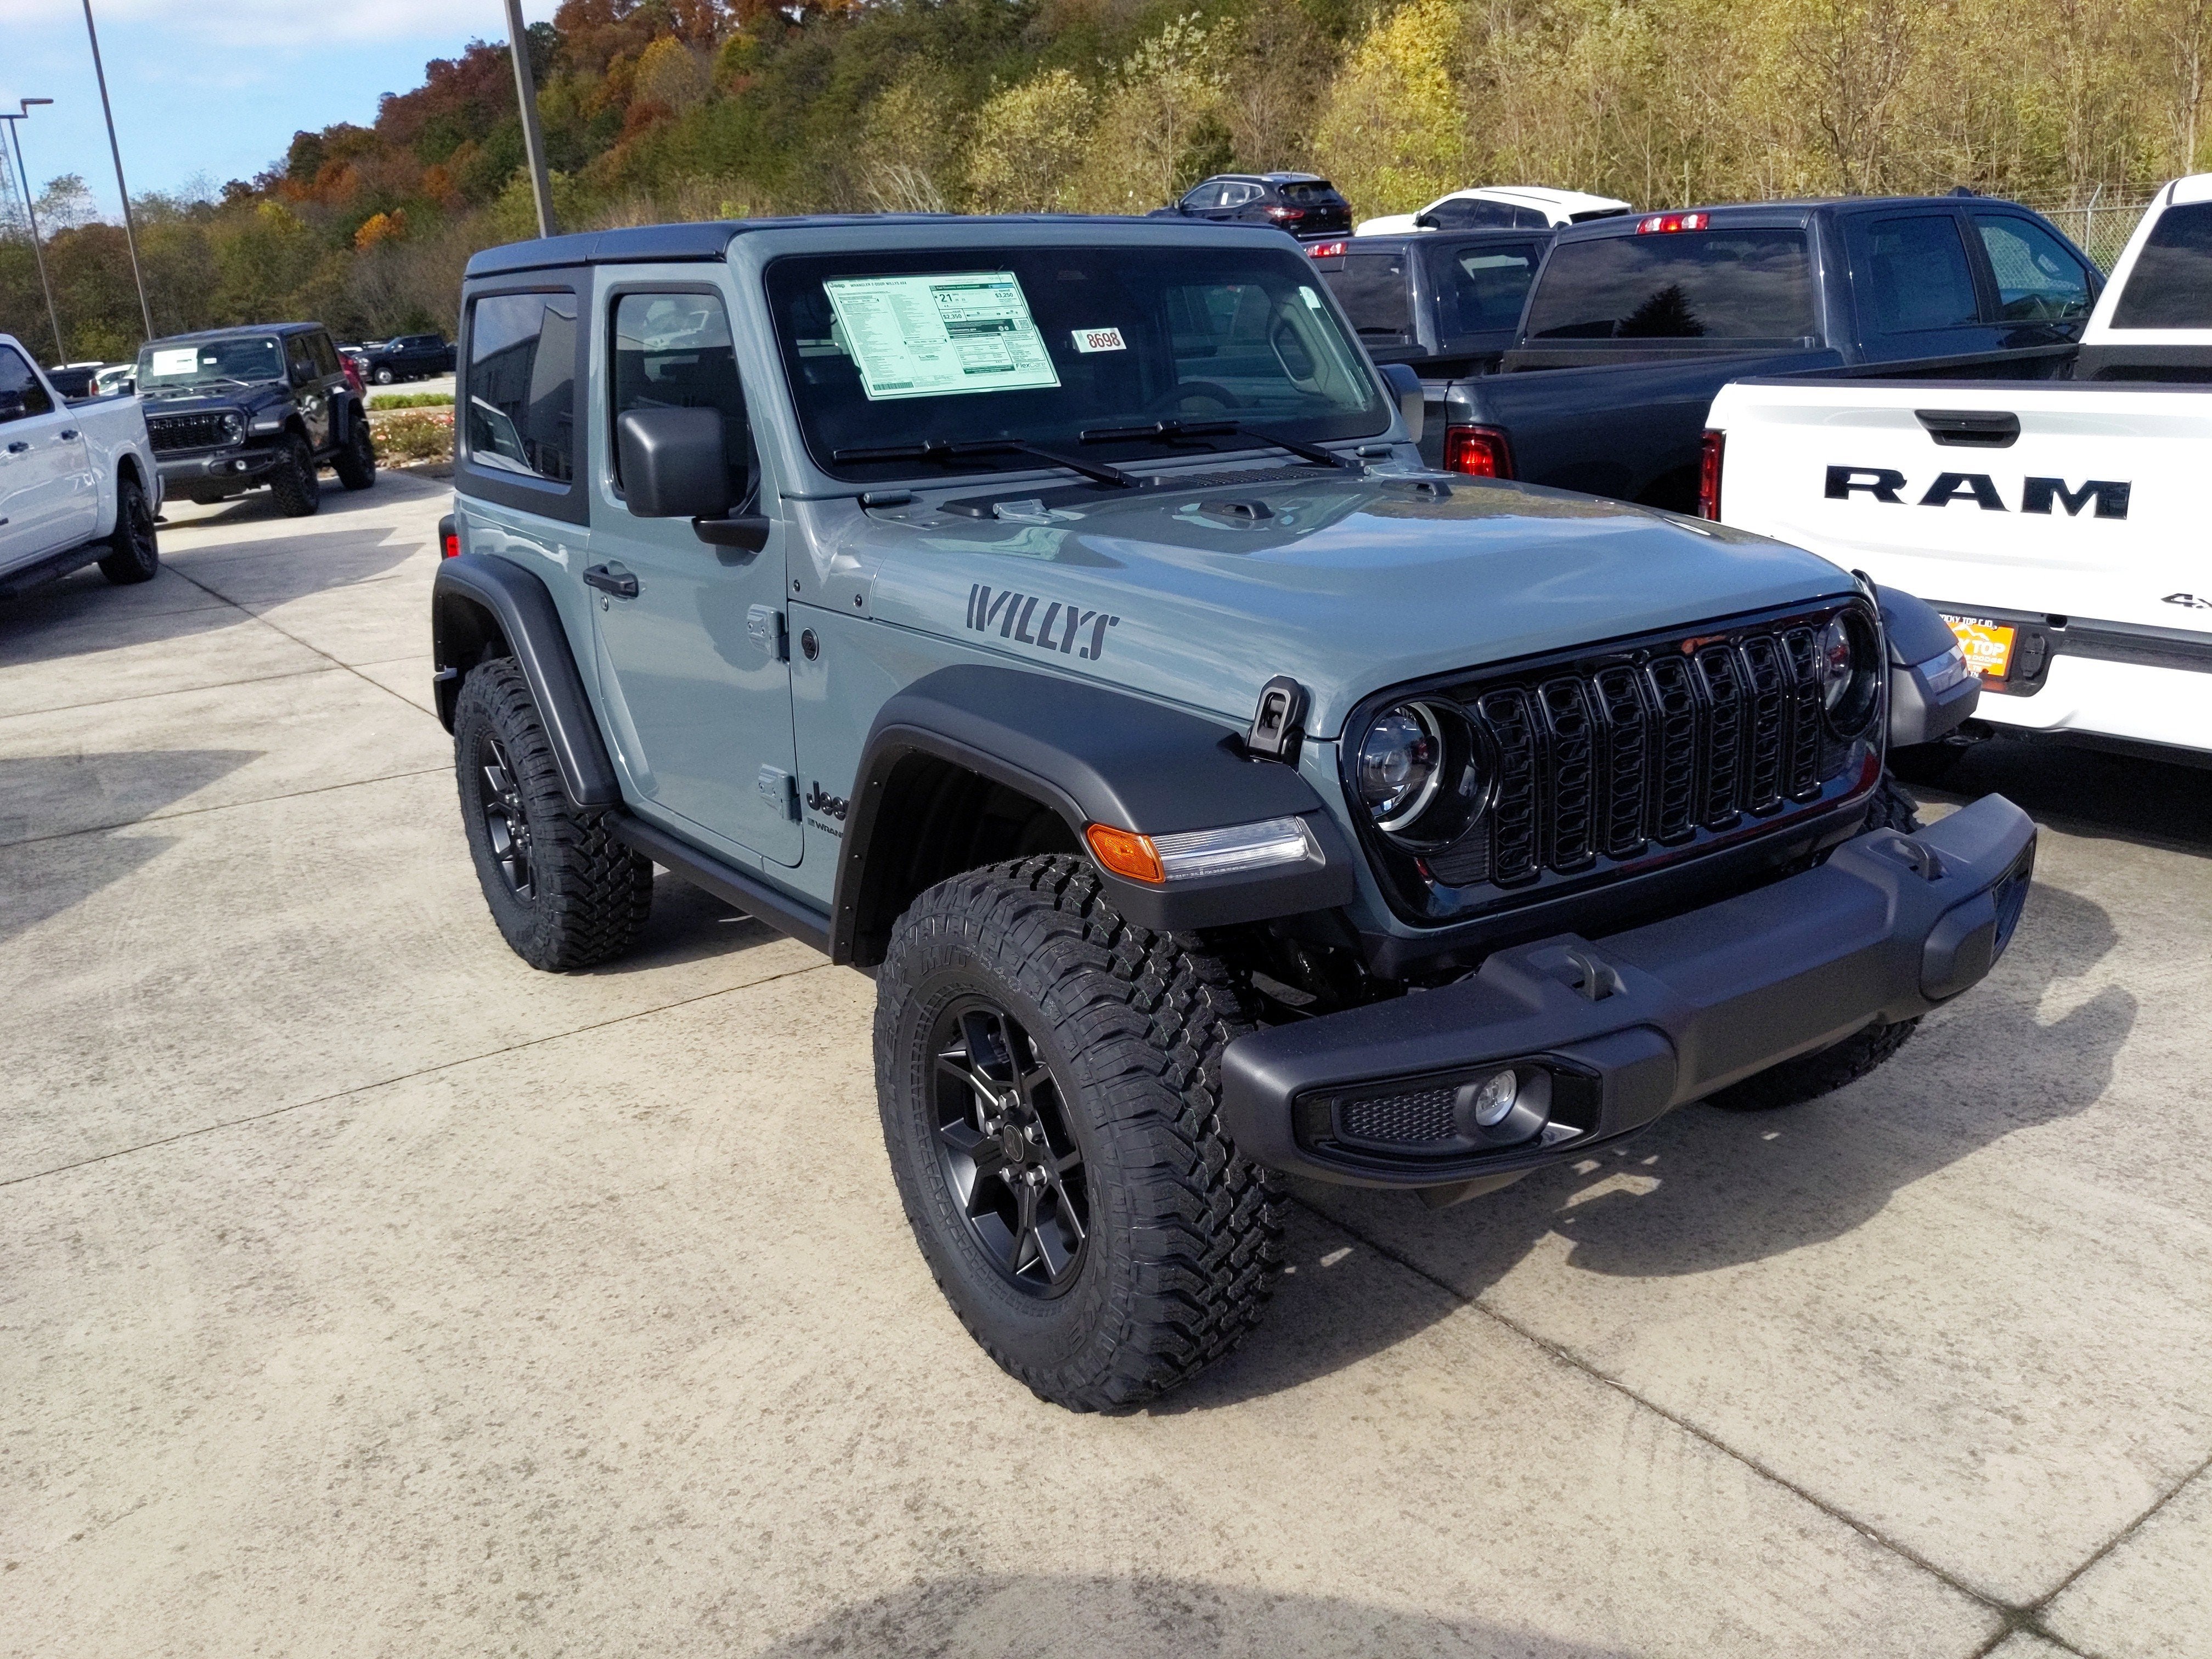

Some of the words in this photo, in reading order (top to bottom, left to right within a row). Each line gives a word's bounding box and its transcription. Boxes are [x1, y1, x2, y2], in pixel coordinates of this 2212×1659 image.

[939, 294, 952, 302] 21
[1087, 332, 1120, 348] 8698
[1824, 463, 2132, 520] RAM
[967, 583, 1120, 661] WILLYS
[1962, 617, 1977, 625] TOP
[1972, 640, 2006, 656] TOP
[806, 780, 850, 821] Jee
[815, 820, 844, 838] WRAN
[922, 944, 972, 977] M/T
